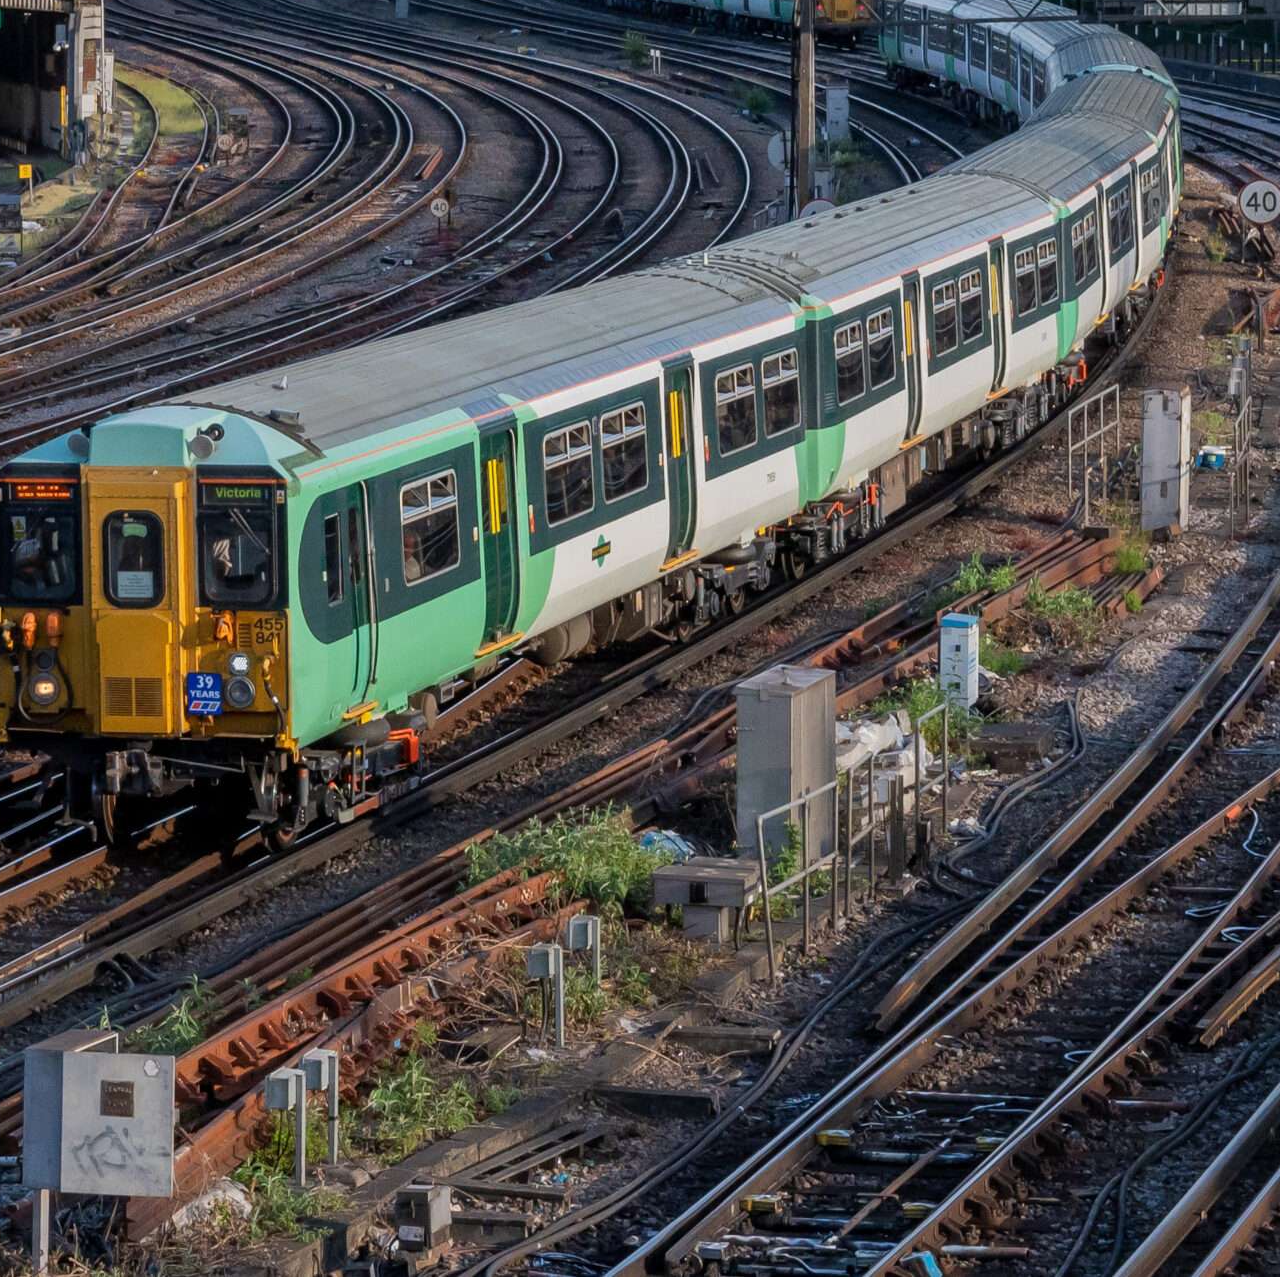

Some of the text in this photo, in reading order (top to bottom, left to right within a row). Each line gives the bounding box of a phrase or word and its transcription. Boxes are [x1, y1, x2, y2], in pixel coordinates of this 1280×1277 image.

[433, 202, 447, 212] 40
[1246, 191, 1277, 213] 40
[215, 487, 261, 499] Victoria
[254, 617, 284, 631] 455
[255, 631, 281, 644] 841
[196, 675, 214, 689] 39
[189, 690, 220, 699] YEARS
